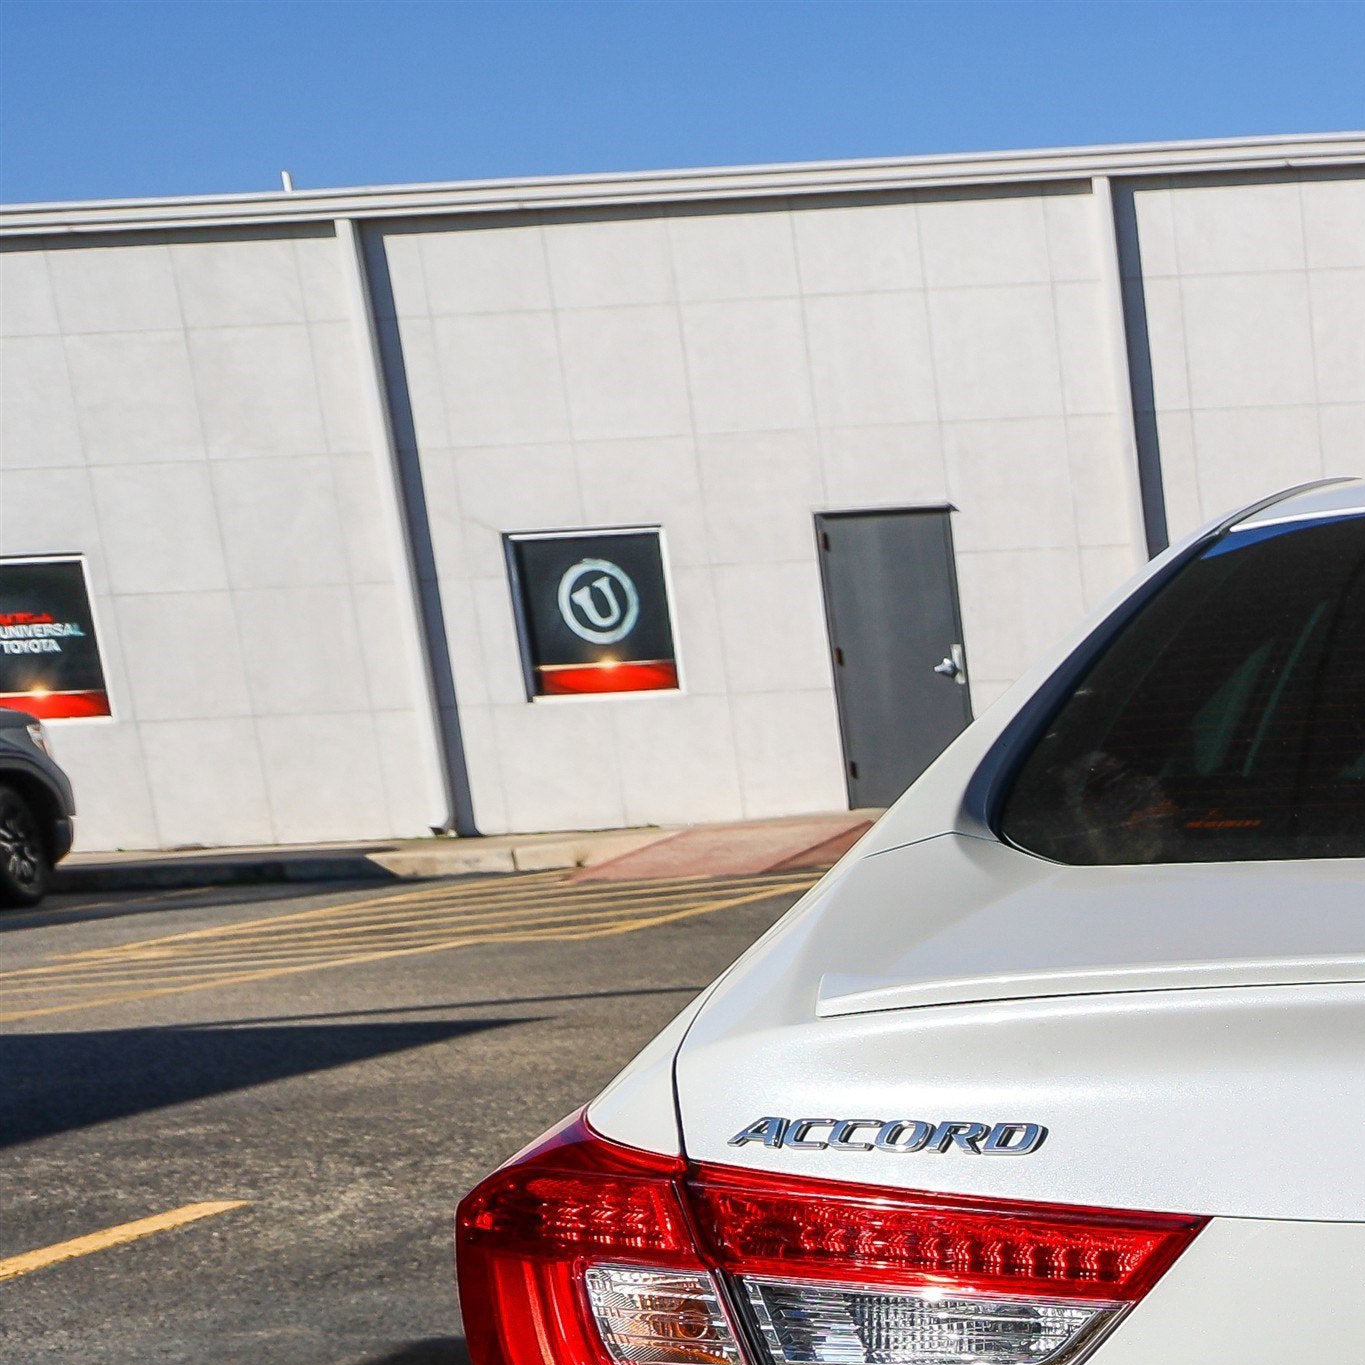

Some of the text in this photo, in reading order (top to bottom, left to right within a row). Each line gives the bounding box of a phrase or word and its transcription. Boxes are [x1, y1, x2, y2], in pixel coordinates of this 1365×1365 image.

[0, 623, 85, 638] UNIVERSAL
[0, 639, 62, 654] TOYOTA
[726, 1116, 1050, 1156] ACCORD
